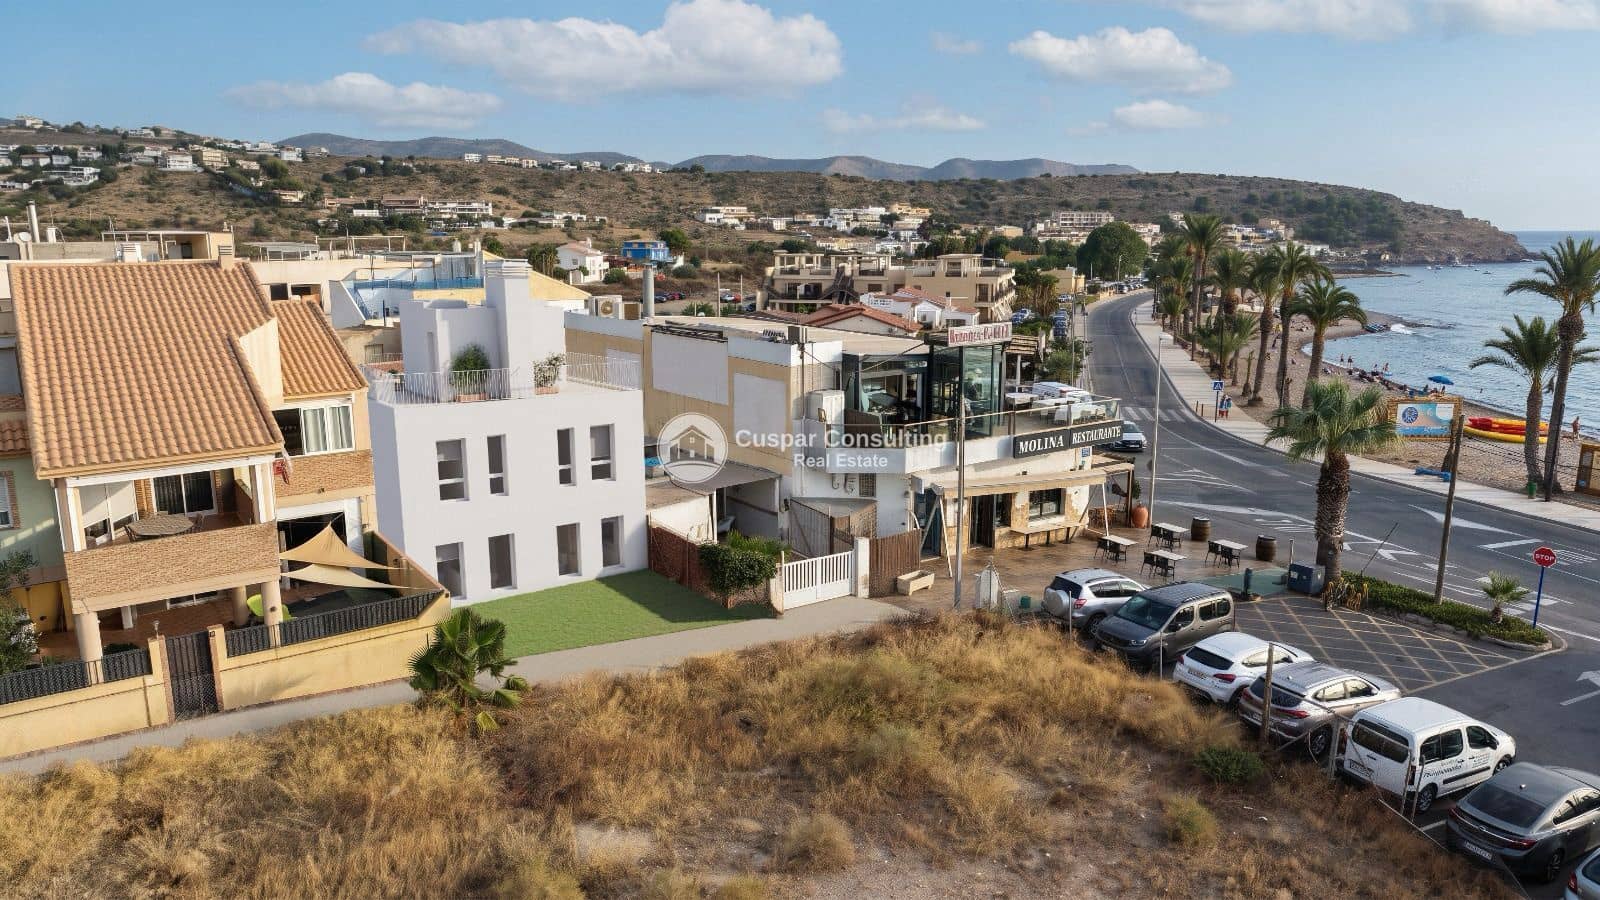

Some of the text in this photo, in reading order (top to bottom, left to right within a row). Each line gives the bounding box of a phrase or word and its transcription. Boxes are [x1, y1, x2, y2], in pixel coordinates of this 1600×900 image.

[1018, 434, 1065, 454] MOLINA
[1072, 425, 1122, 445] RESTAURANTE
[1535, 553, 1555, 561] STOP
